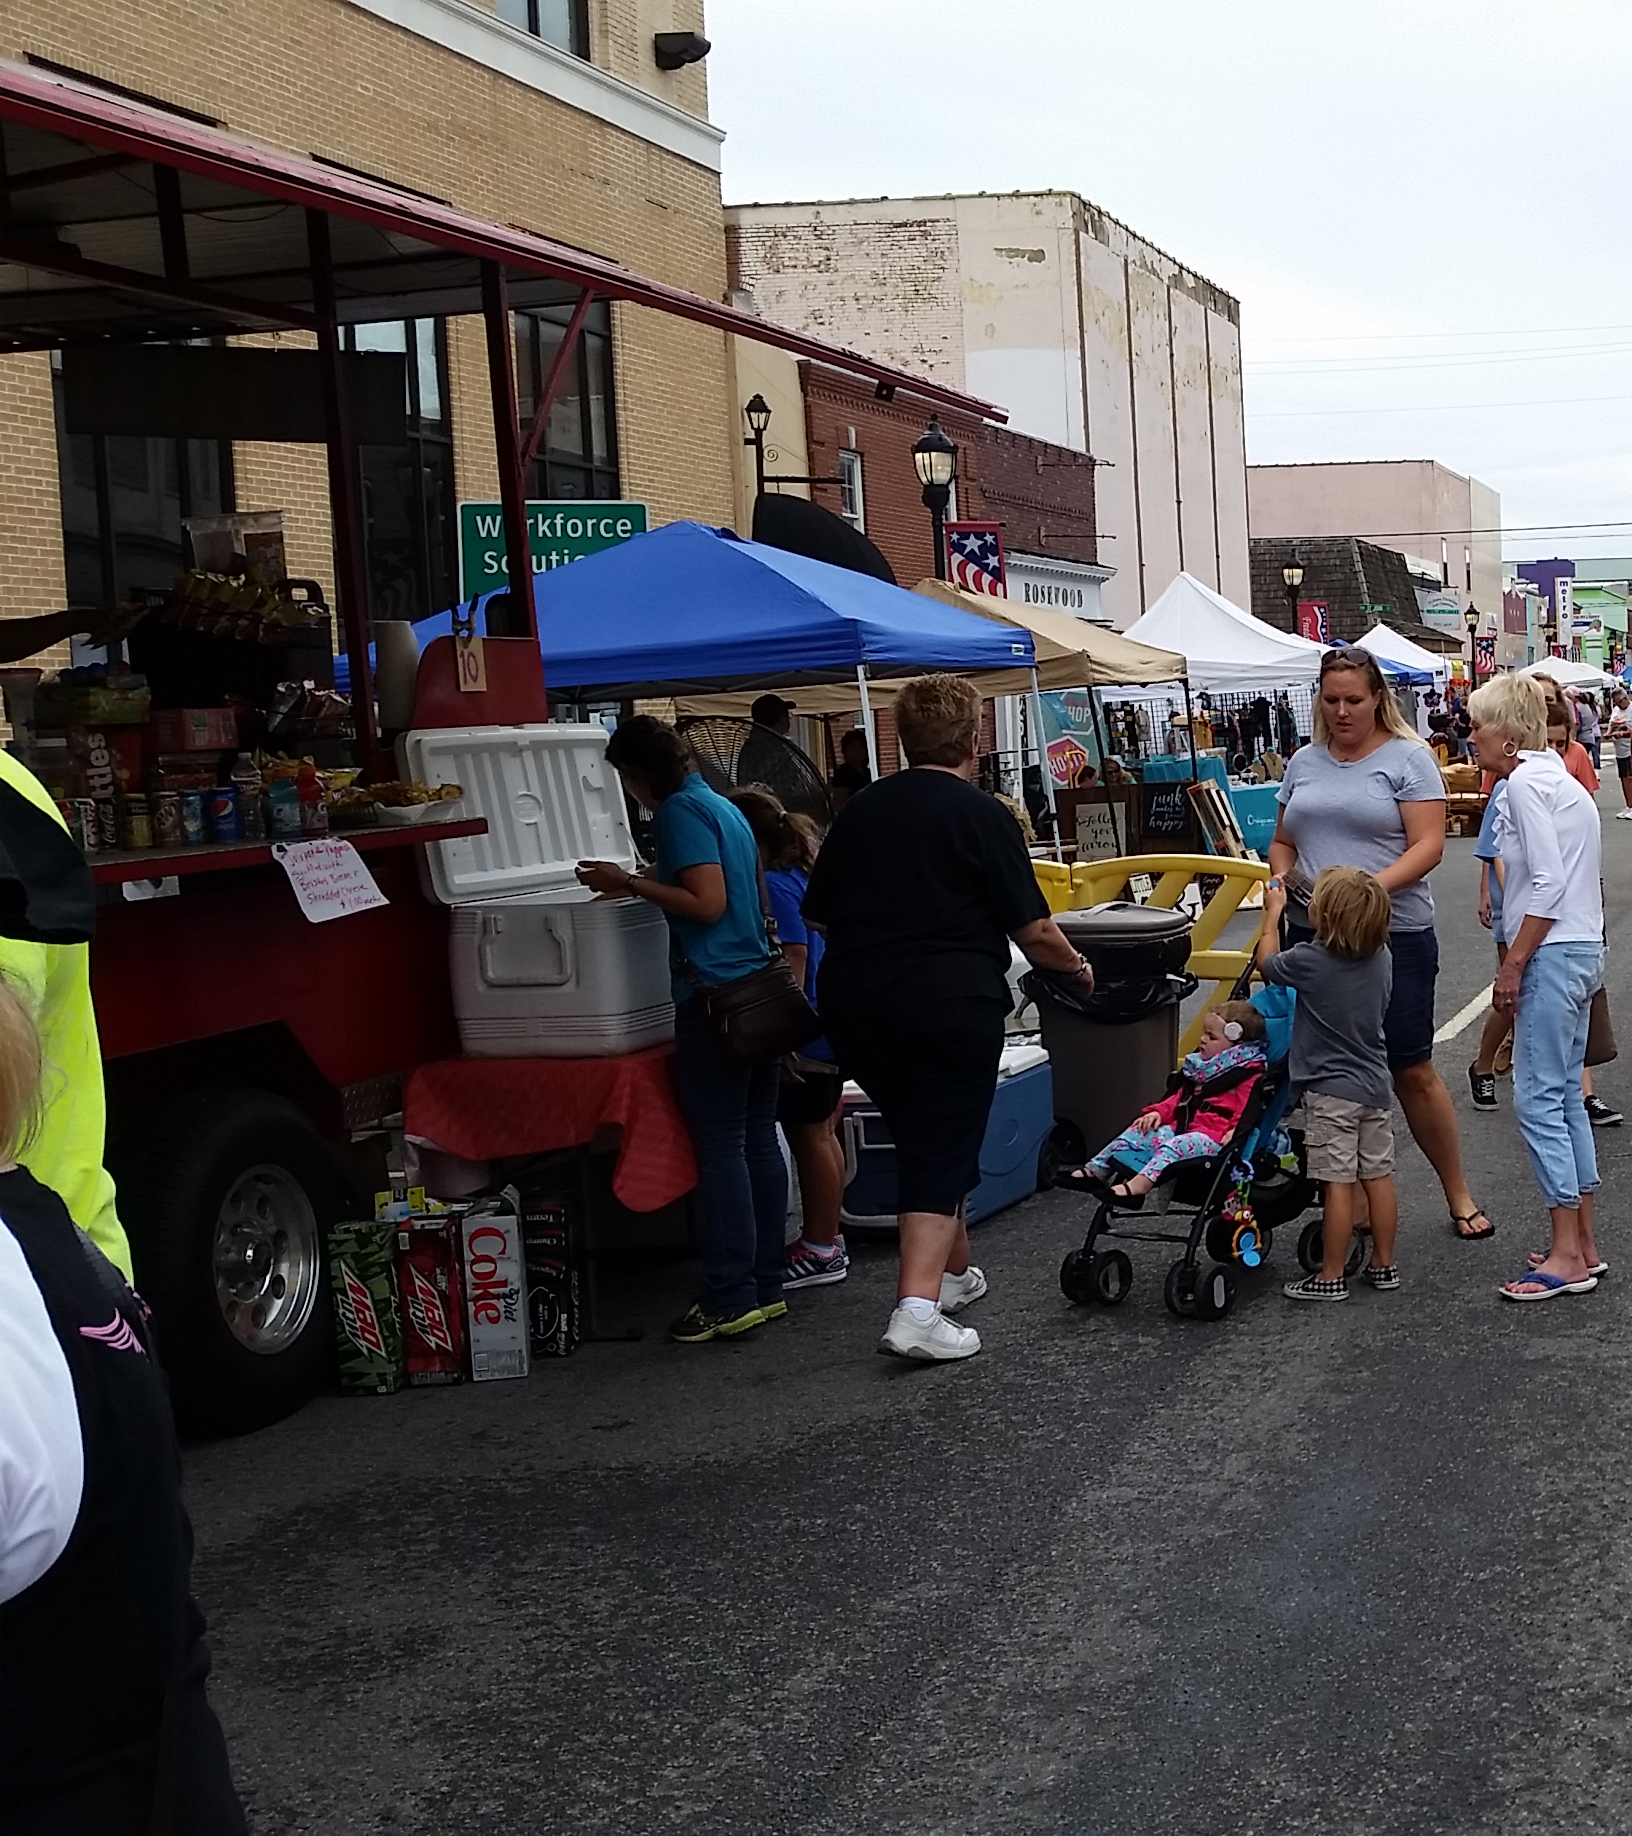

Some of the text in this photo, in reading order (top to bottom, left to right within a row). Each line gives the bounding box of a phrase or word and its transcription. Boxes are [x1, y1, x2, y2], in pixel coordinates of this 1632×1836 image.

[475, 513, 633, 538] Wrkforce
[1024, 582, 1084, 608] ROSEWOOD
[1559, 580, 1569, 619] metro
[459, 649, 479, 685] 10
[1150, 784, 1183, 814] junk
[1149, 816, 1184, 831] happy
[468, 1226, 508, 1326] Coke
